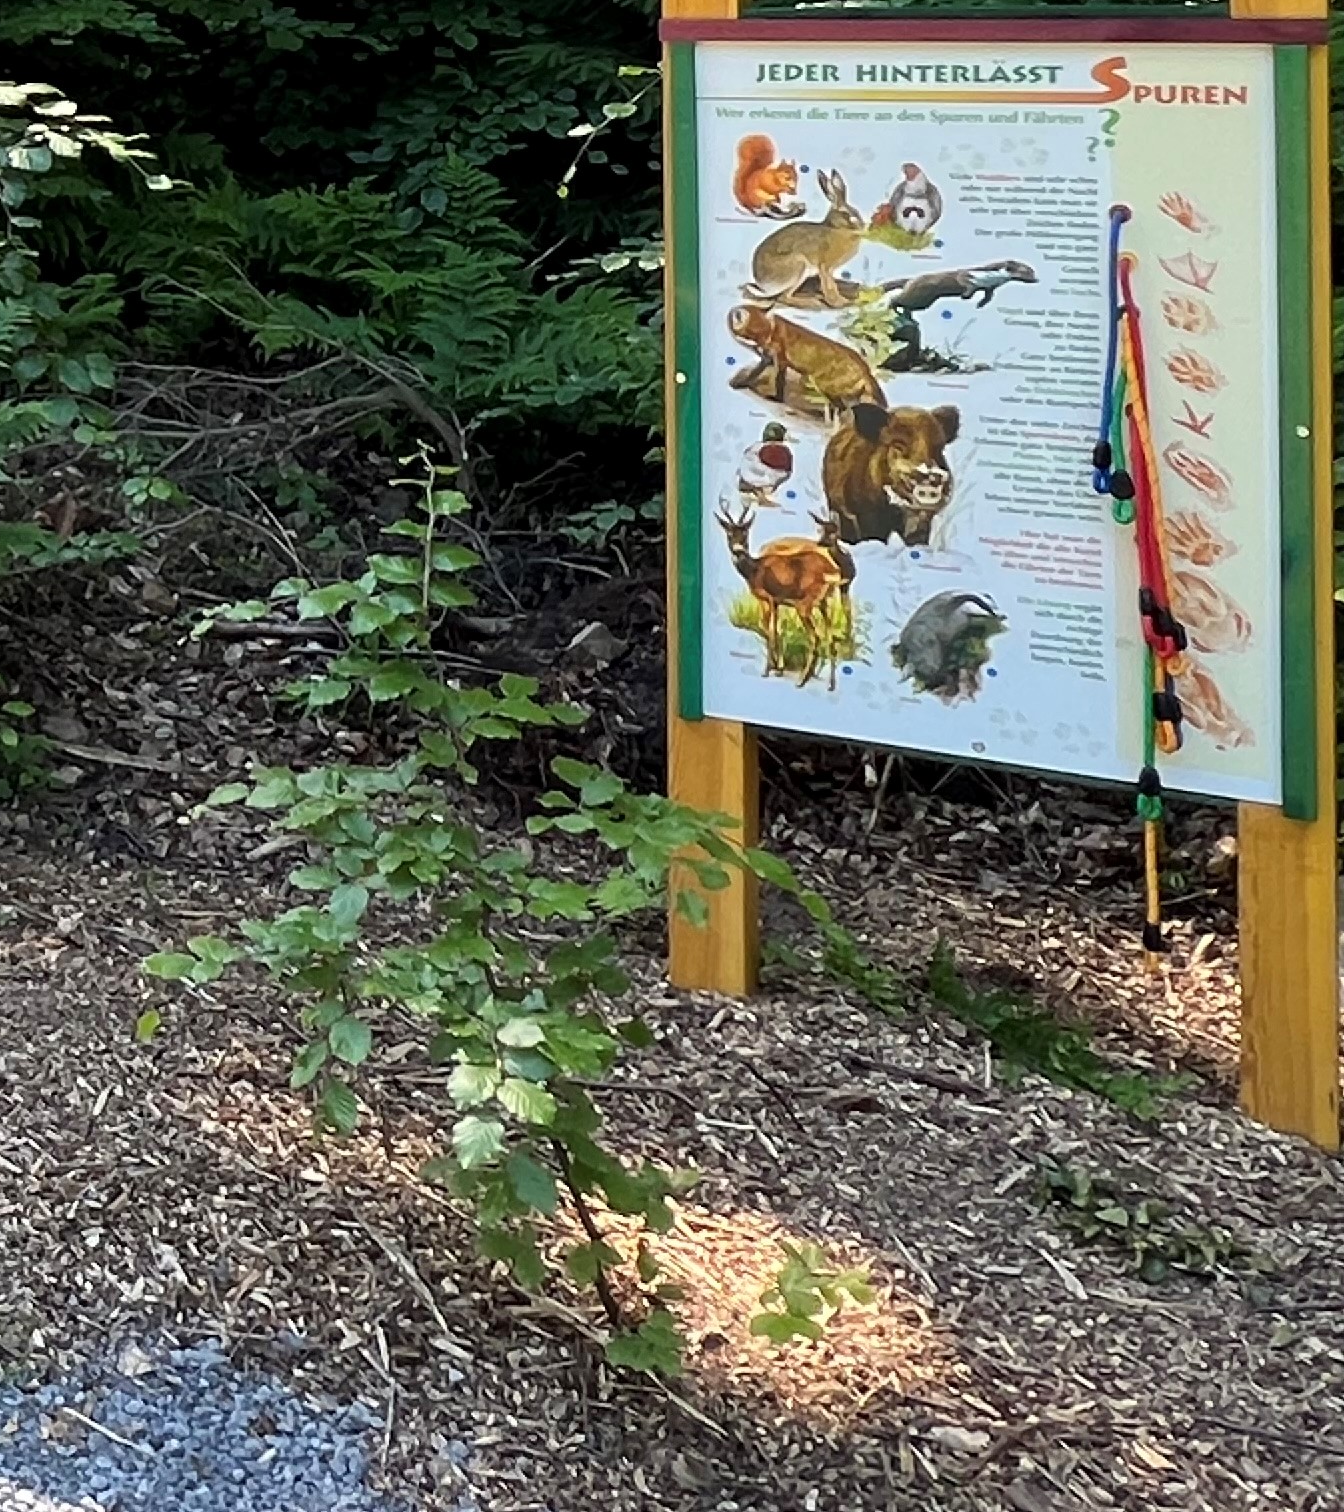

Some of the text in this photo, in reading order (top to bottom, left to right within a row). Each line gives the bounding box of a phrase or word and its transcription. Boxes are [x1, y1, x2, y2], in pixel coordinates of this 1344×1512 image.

[755, 63, 840, 83] JEDER
[855, 59, 1064, 85] HINTERLÄSST
[714, 106, 745, 119] Wer
[748, 106, 802, 120] erkennt
[806, 106, 830, 120] die
[834, 107, 870, 120] Tiere
[874, 112, 894, 122] an
[896, 108, 926, 122] den
[929, 109, 984, 125] Spuren
[988, 110, 1019, 124] und
[1023, 110, 1084, 124] Fährten
